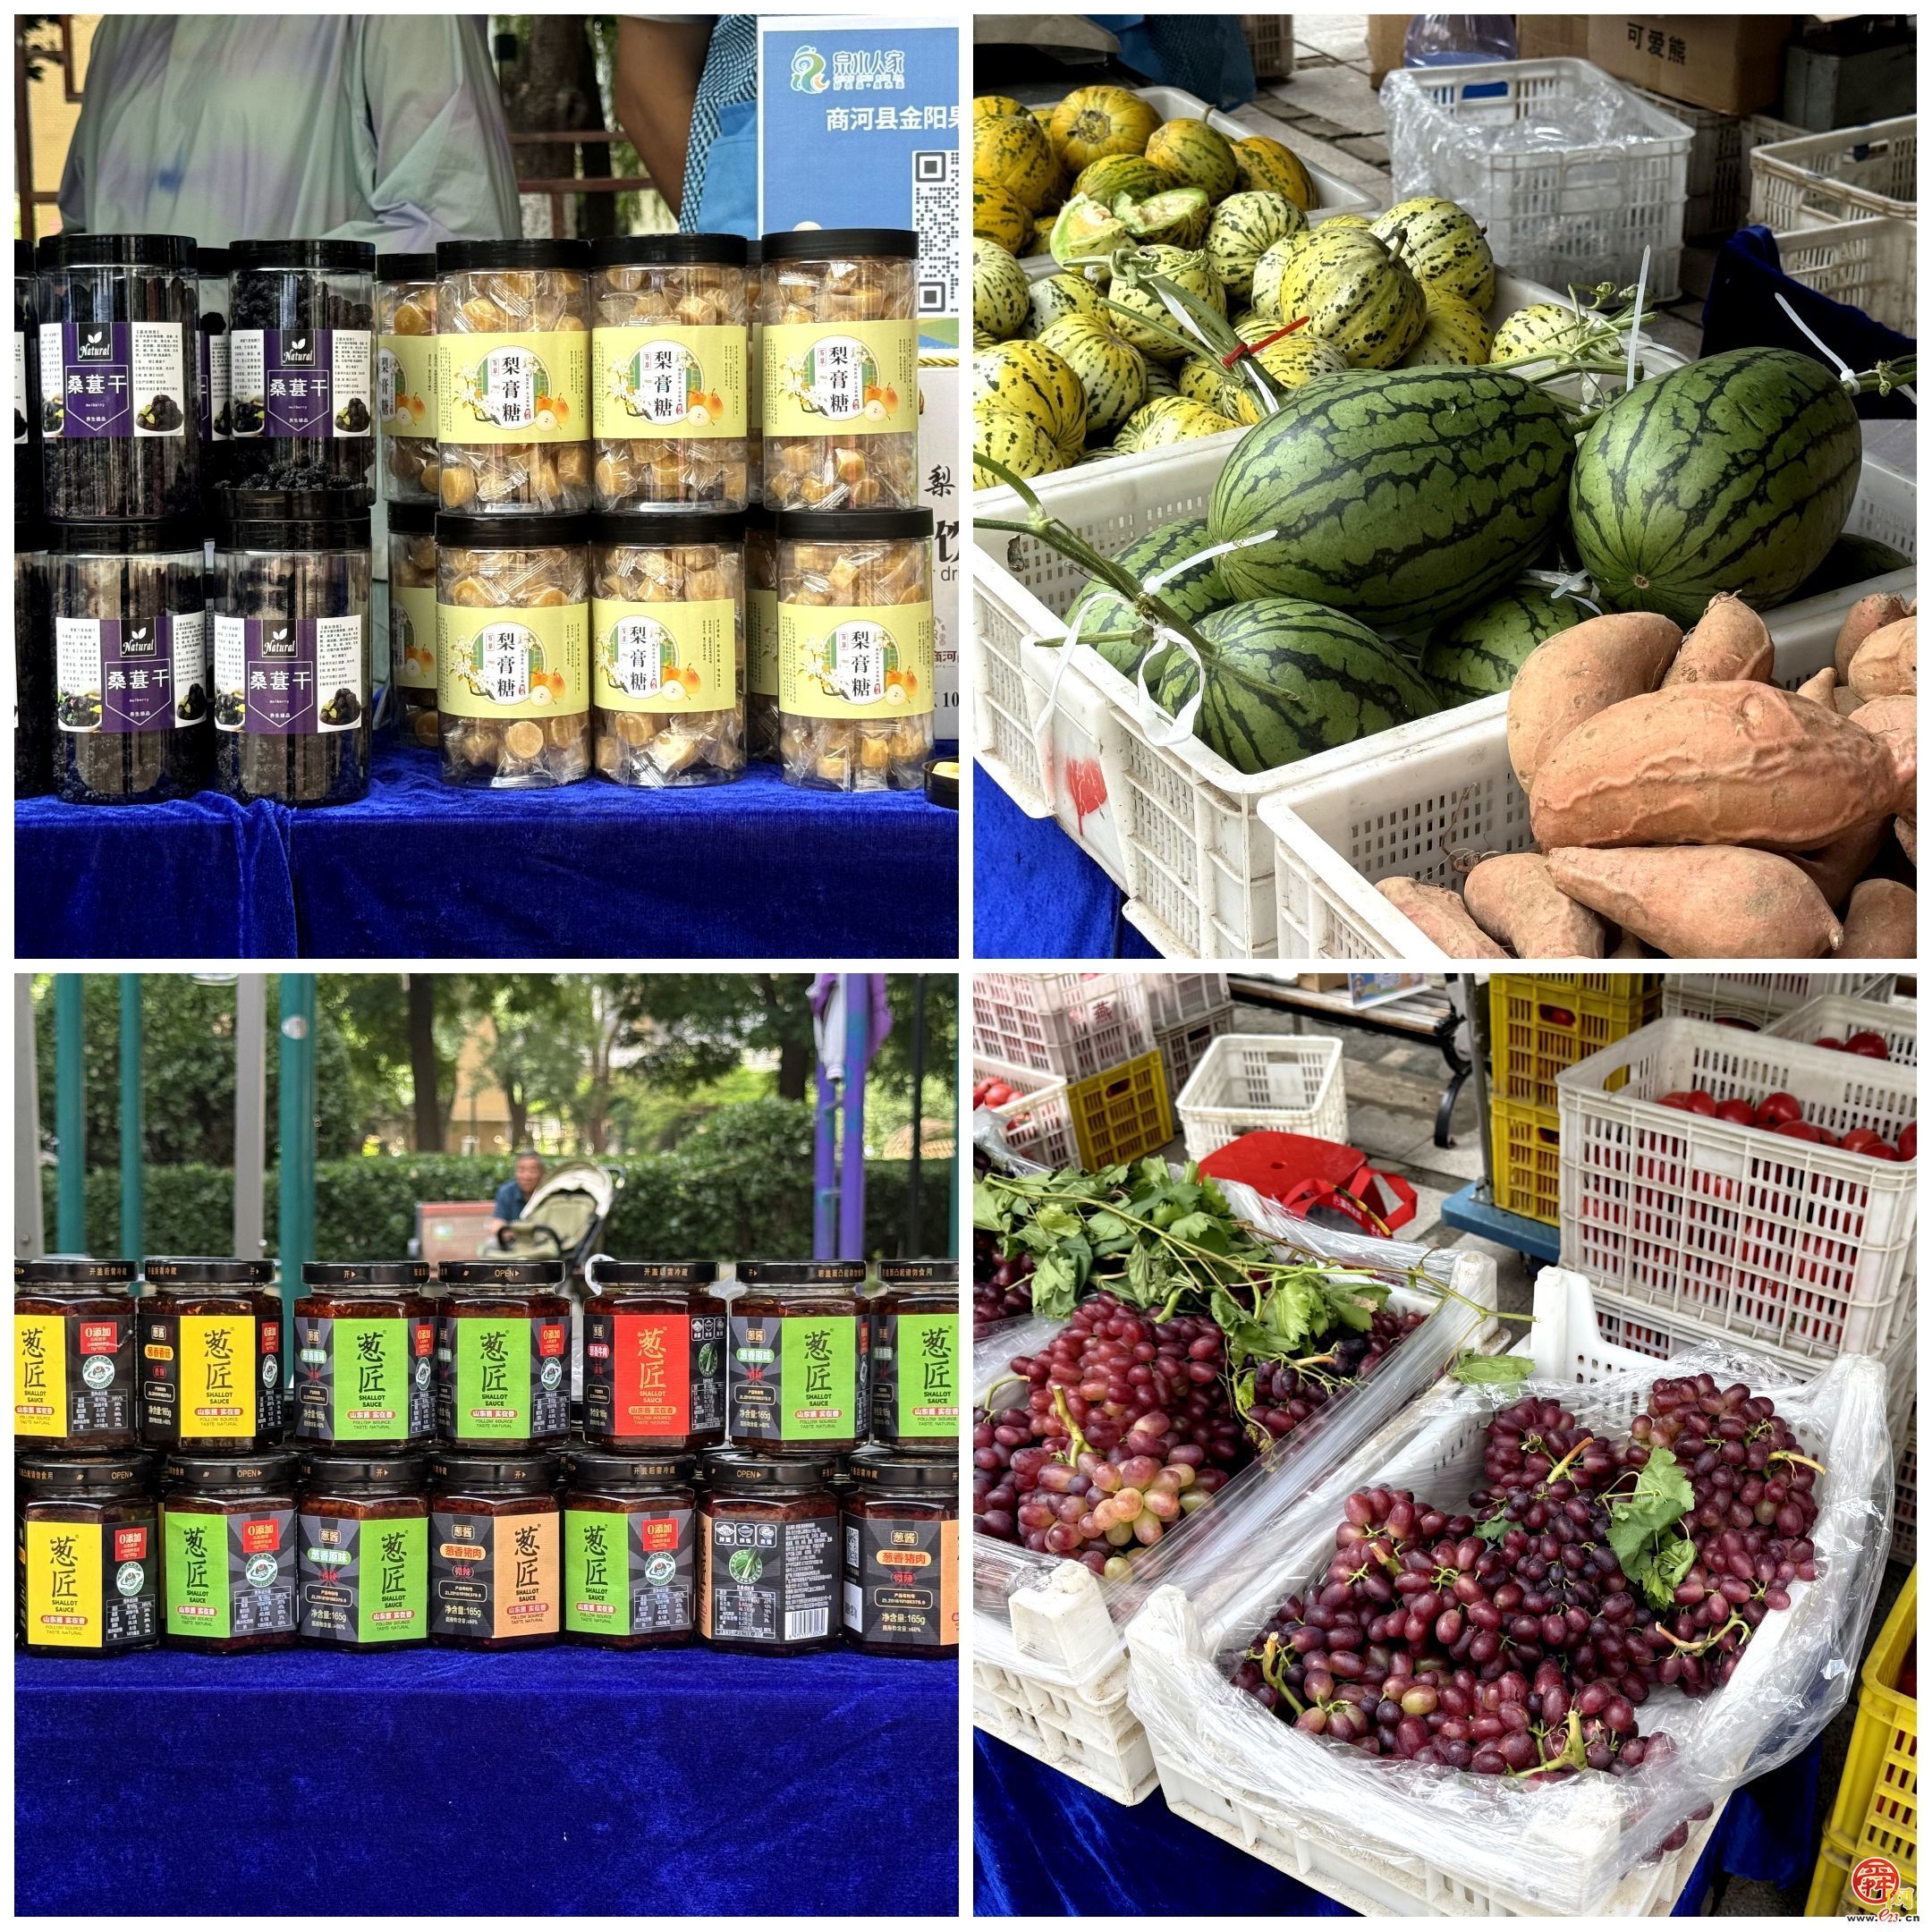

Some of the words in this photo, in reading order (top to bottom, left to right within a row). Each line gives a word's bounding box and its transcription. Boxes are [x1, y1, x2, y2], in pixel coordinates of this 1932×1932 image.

[834, 50, 905, 74] 泉水人家
[79, 343, 110, 359] Natural
[283, 350, 313, 363] Natural
[68, 374, 127, 394] 桑葚干
[270, 378, 327, 397] 桑葚干
[654, 351, 673, 418] 梨膏糖
[829, 346, 849, 413] 梨膏糖
[502, 357, 521, 422] 梨膏糖
[924, 464, 956, 497] 梨
[123, 640, 154, 655] Natural
[264, 640, 295, 655] Natural
[497, 632, 516, 698] 梨膏糖
[630, 625, 648, 691] 梨膏糖
[852, 631, 871, 697] 梨膏糖
[108, 669, 170, 691] 桑葚干
[250, 671, 311, 691] 桑葚干
[1093, 1001, 1113, 1026] 燕
[343, 1269, 351, 1279] 开
[495, 1269, 514, 1277] OPEN
[644, 1267, 688, 1276] 开盖后需冷藏
[85, 1326, 111, 1337] 0添加
[21, 1327, 47, 1388] 葱匠
[204, 1328, 233, 1390] 葱匠
[357, 1331, 386, 1393] 葱匠
[480, 1331, 508, 1392] 葱匠
[637, 1327, 667, 1389] 葱匠
[804, 1330, 833, 1393] 葱匠
[921, 1326, 952, 1390] 葱匠
[111, 1471, 130, 1479] OPEN
[237, 1470, 257, 1478] OPEN
[376, 1468, 383, 1477] 开
[514, 1470, 521, 1479] 开
[736, 1470, 756, 1479] OPEN
[248, 1525, 274, 1535] 0添加
[321, 1530, 339, 1543] 葱酱
[454, 1526, 472, 1538] 葱酱
[648, 1523, 673, 1534] 0添加
[120, 1533, 141, 1544] 0添加
[894, 1532, 915, 1543] 葱酱
[184, 1526, 209, 1589] 葱匠
[311, 1549, 347, 1563] 葱香原味
[445, 1546, 482, 1558] 葱香猪肉
[514, 1526, 540, 1589] 葱匠
[584, 1525, 608, 1586] 葱匠
[883, 1553, 926, 1564] 葱香猪肉
[50, 1535, 79, 1597] 葱匠
[381, 1531, 407, 1595] 葱匠
[311, 1609, 347, 1623] 净含量:165g
[445, 1605, 481, 1618] 净含量:165g
[882, 1613, 926, 1625] 净含量:165g
